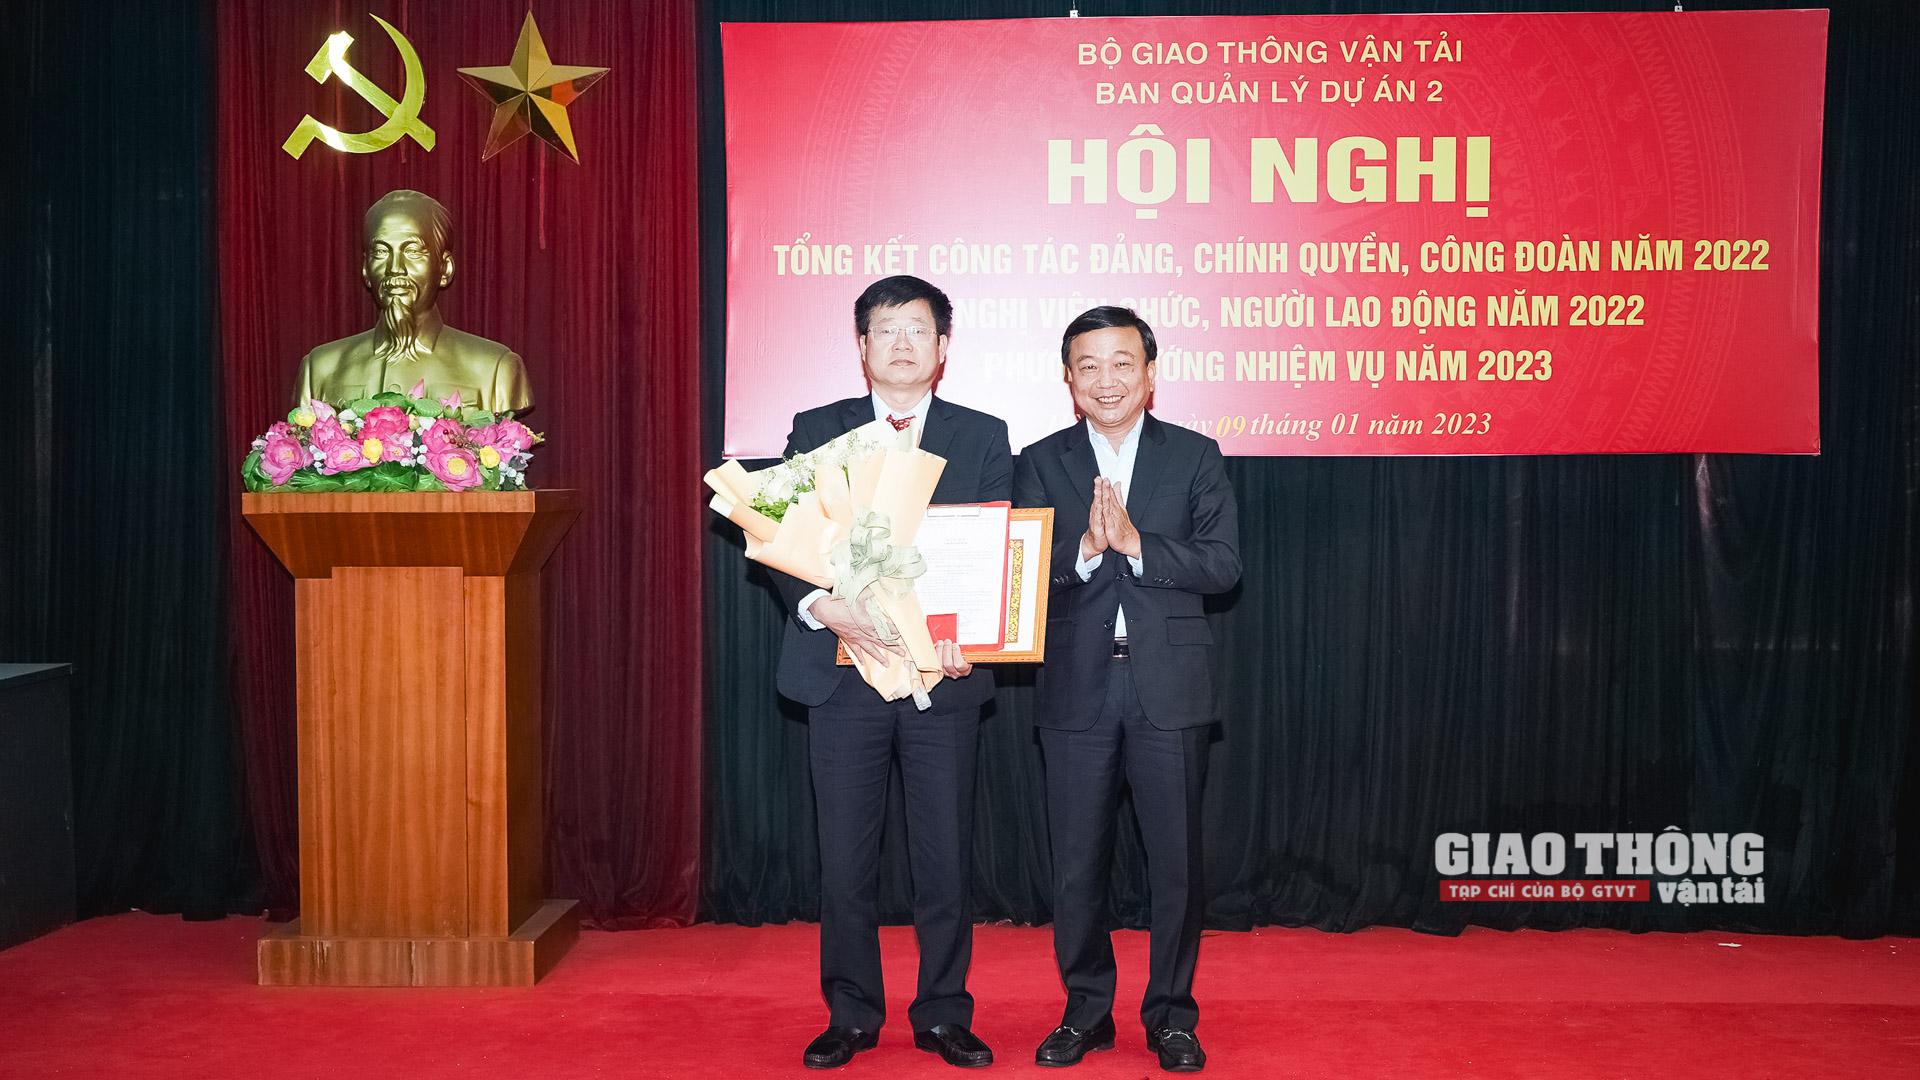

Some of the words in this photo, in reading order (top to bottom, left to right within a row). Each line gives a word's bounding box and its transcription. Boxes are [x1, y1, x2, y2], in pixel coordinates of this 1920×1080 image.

[1078, 37, 1122, 70] BỘ
[1131, 41, 1208, 65] GIAO
[1217, 36, 1327, 65] THÔNG
[1339, 34, 1402, 68] VẬN
[1413, 31, 1462, 63] TẢI
[1096, 82, 1159, 105] BAN
[1171, 72, 1259, 105] QUẢN
[1271, 75, 1310, 103] LÝ
[1321, 77, 1366, 107] DỰ
[1373, 75, 1416, 103] ÁN
[1426, 80, 1443, 103] 2
[1048, 124, 1211, 219] HỘI
[1251, 136, 1491, 218] NGHỊ
[773, 232, 853, 276] TỔNG
[864, 234, 919, 275] KẾT
[929, 238, 1012, 275] CÔNG
[1023, 237, 1079, 275] TÁC
[1089, 233, 1183, 278] ĐẢNG,
[1194, 235, 1288, 275] CHÍNH
[1299, 231, 1409, 277] QUYỀN,
[1420, 235, 1504, 273] CÔNG
[1514, 234, 1600, 272] ĐOÀN
[1611, 233, 1683, 271] NĂM
[1693, 239, 1770, 271] 2022
[954, 297, 1028, 334] NGHỊ
[1220, 288, 1315, 329] NGƯỜI
[1325, 296, 1381, 328] LAO
[1390, 289, 1476, 334] ĐỘNG
[1487, 289, 1559, 327] NĂM
[1569, 295, 1645, 326] 2022
[1235, 344, 1336, 389] NHIỆM
[1346, 350, 1385, 388] VỤ
[1395, 343, 1467, 381] NĂM
[1477, 350, 1552, 381] 2023
[1216, 415, 1246, 439] 09
[1250, 412, 1323, 442] tháng
[1331, 412, 1359, 435] 01
[1368, 413, 1423, 435] năm
[1431, 412, 1492, 435] 2023
